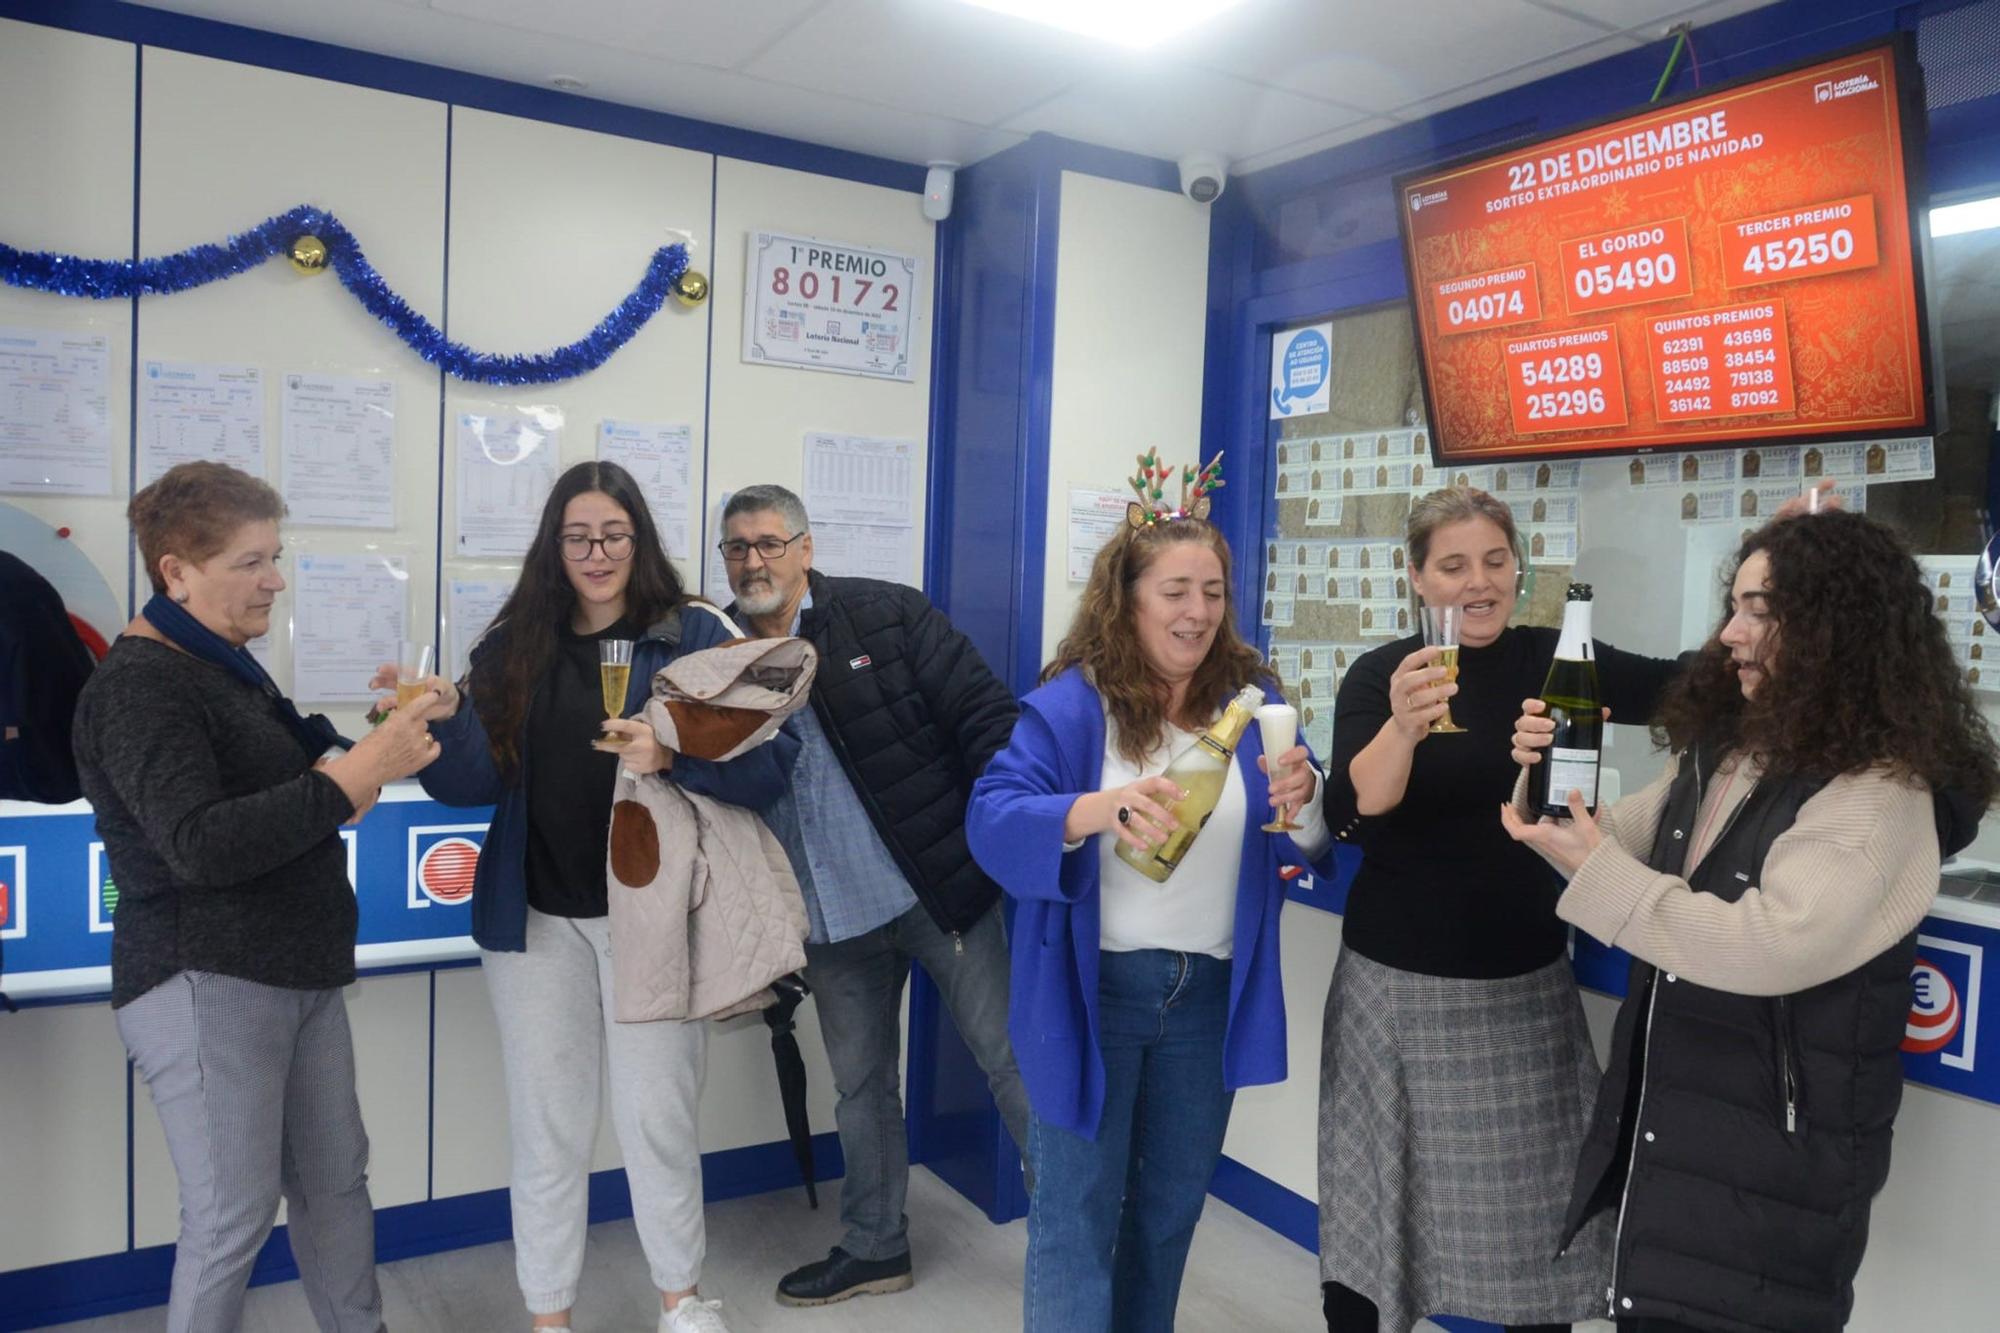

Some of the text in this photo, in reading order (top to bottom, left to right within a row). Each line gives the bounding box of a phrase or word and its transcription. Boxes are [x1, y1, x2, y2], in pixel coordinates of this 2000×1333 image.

[1835, 80, 1879, 98] NACIONAL
[1508, 111, 1728, 191] 22 DE DICIEMBRE
[1486, 133, 1764, 213] SORTEO EXTRAORDINARIO DE NAVIDAD
[1738, 204, 1852, 237] TERCER PREMIO
[1579, 228, 1665, 259] EL GORDO
[1743, 229, 1854, 274] 45250
[808, 249, 887, 277] PREMIO
[1575, 253, 1676, 299] 05490
[772, 266, 899, 312] 80172
[1440, 268, 1527, 296] SEGUNDO PREMIO
[1448, 290, 1524, 326] 04074
[1654, 306, 1774, 334] QUINTOS PREMIOS
[831, 335, 860, 346] Nacional
[1508, 330, 1609, 354] CUARTOS PREMIOS
[1663, 327, 1773, 355] 62391 43696
[1521, 352, 1602, 387] 54289
[1662, 348, 1775, 375] 88509 38454
[1665, 369, 1774, 394] 24492 79138
[1526, 387, 1605, 419] 25296
[1669, 390, 1778, 413] 36142 87092
